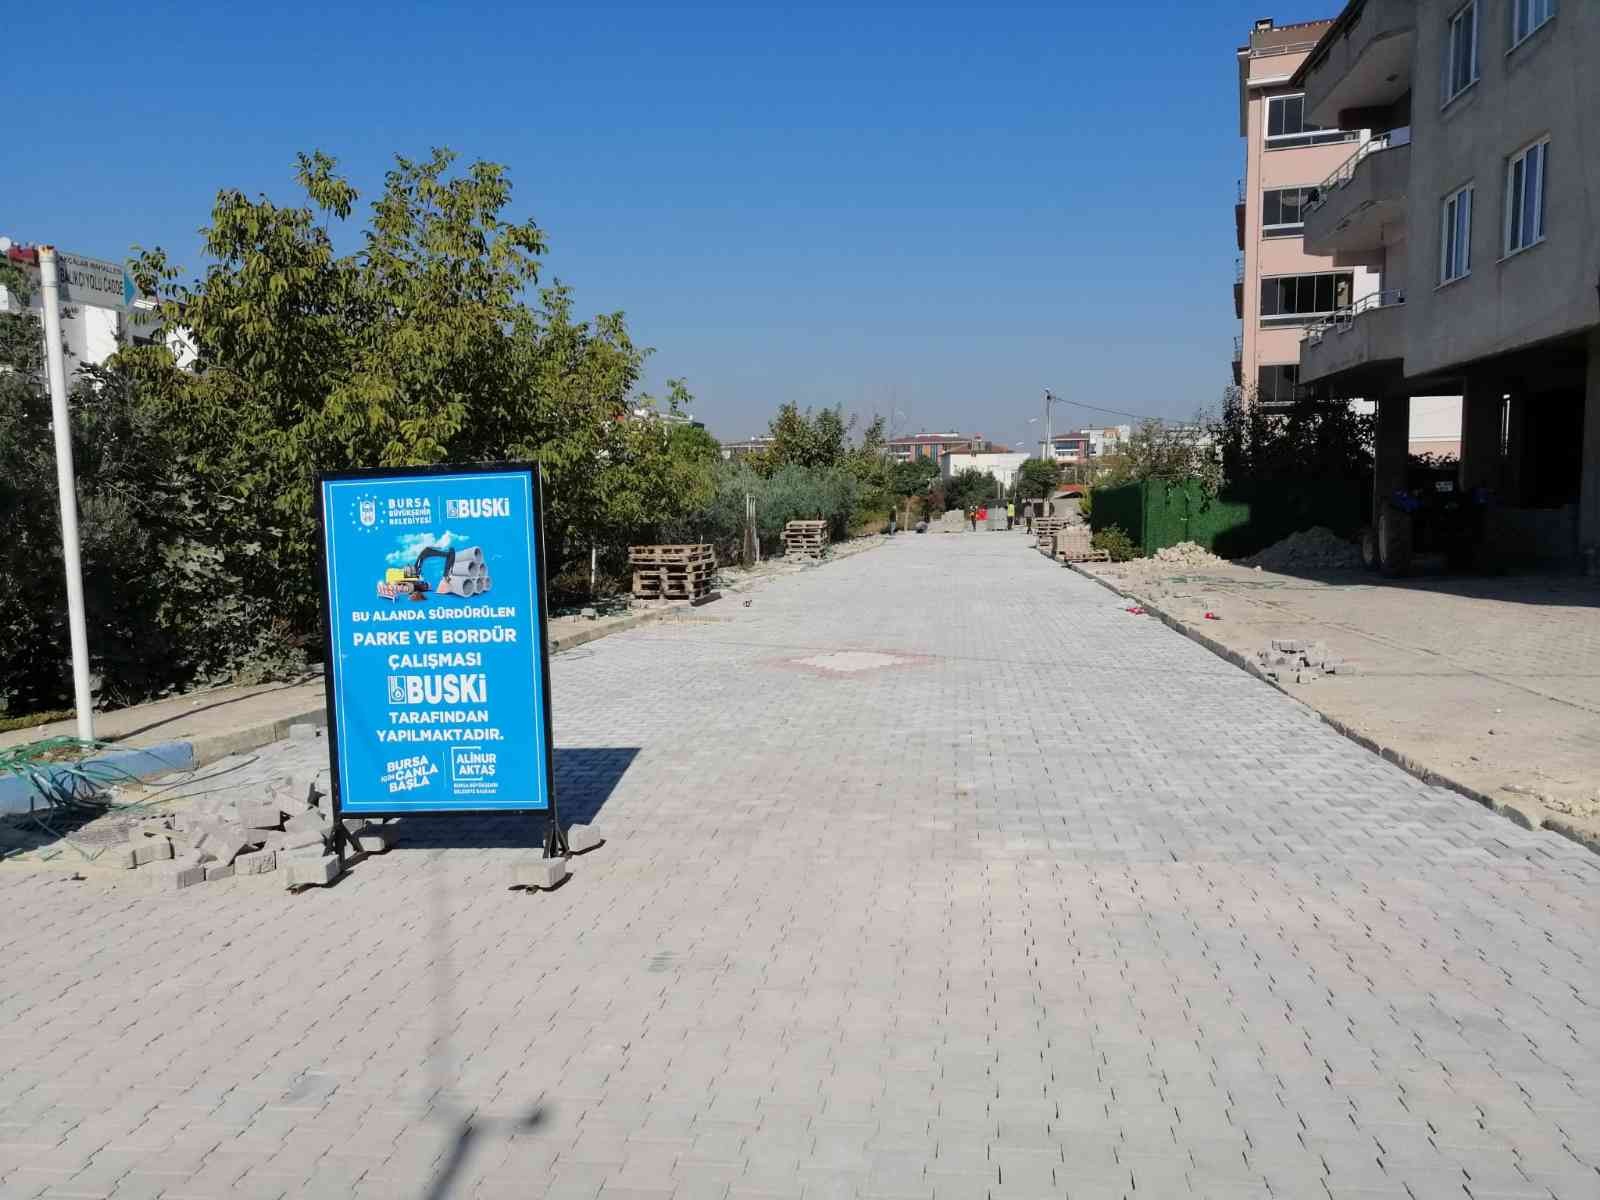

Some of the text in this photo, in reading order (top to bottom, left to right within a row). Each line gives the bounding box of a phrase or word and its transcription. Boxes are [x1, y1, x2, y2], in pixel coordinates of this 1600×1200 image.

[388, 498, 431, 509] BURSA
[352, 606, 515, 622] BU ALANDA SÜRDÜRÜLEN
[353, 625, 517, 646] PARKE VE BORDÜR
[388, 652, 481, 670] ÇALIŞMASI
[389, 710, 489, 724] TARAFINDAN
[376, 728, 504, 743] YAPILMAKTADIR.
[387, 755, 429, 772] BURSA
[456, 751, 497, 764] ALİNUR
[395, 763, 439, 781] CANLA
[459, 765, 496, 776] AKTAŞ
[389, 776, 430, 792] BAŞLA
